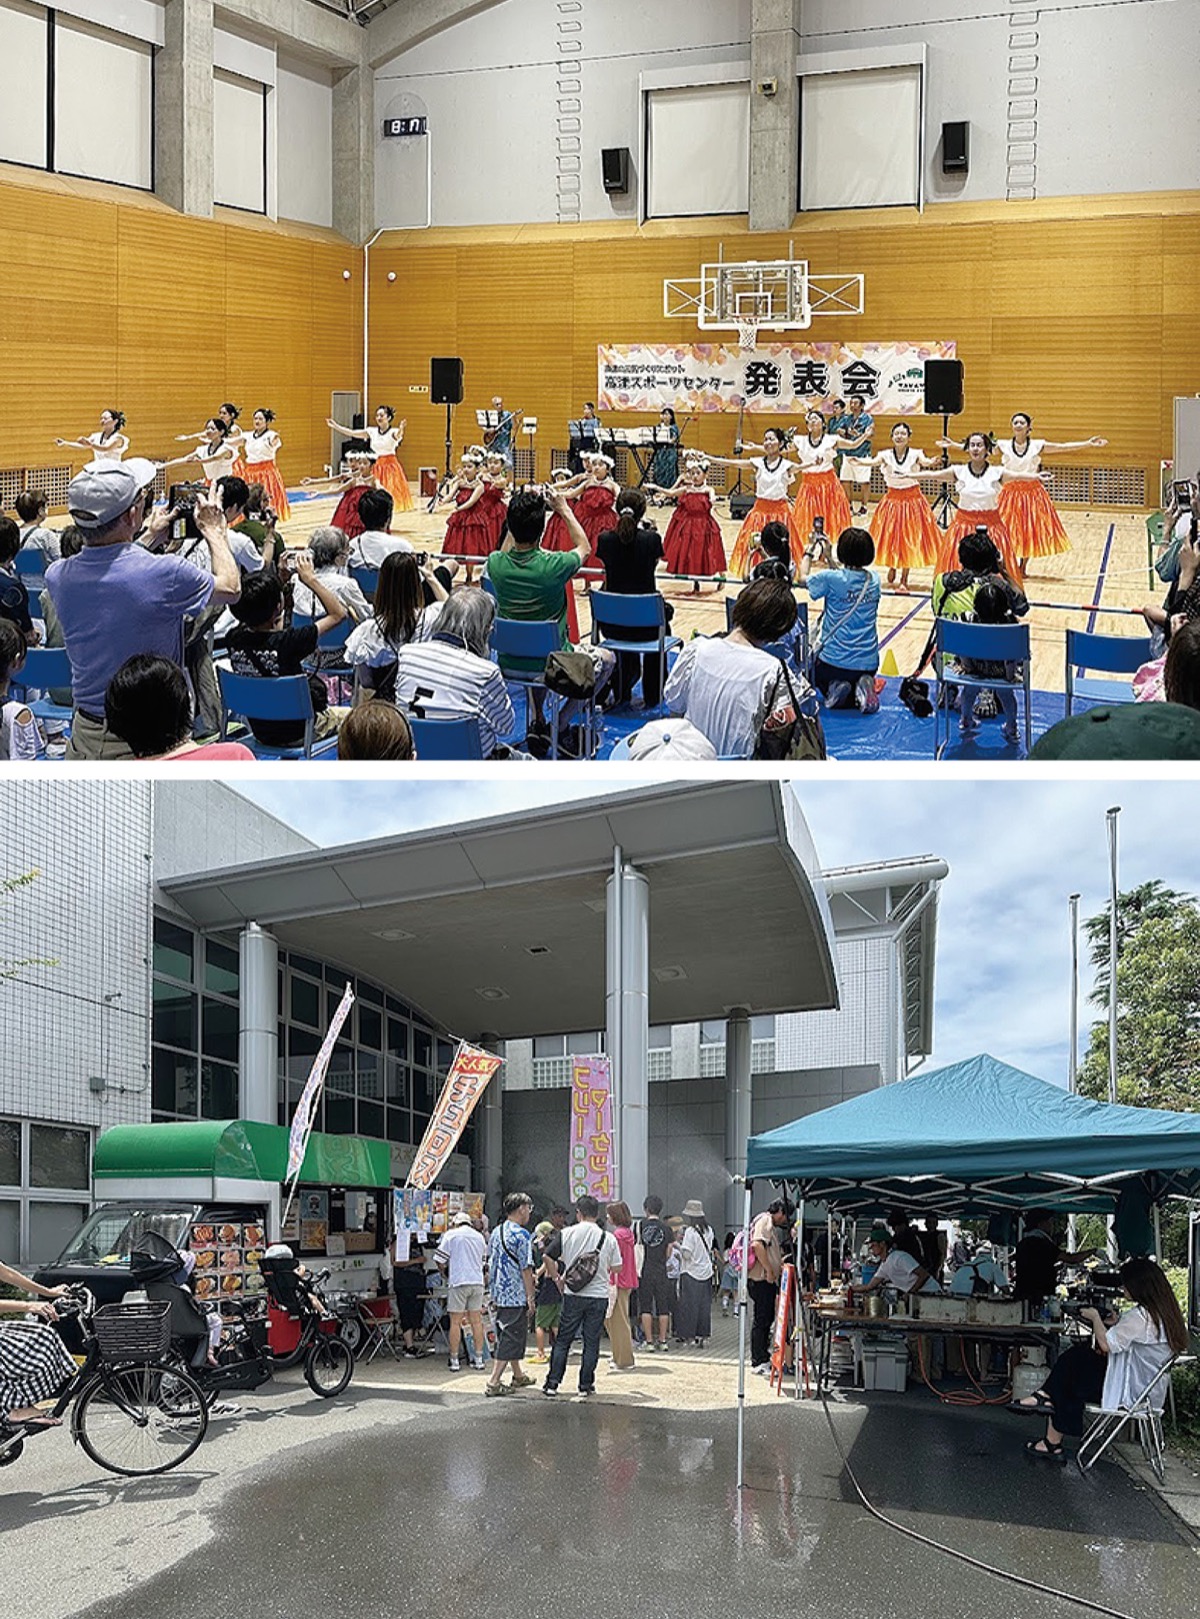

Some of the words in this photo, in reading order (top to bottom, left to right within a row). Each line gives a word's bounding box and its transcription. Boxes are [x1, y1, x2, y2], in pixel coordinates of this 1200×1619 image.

[605, 376, 734, 391] 高津スポーツセンター
[745, 361, 882, 398] 発表会
[413, 1075, 478, 1186] チュロス
